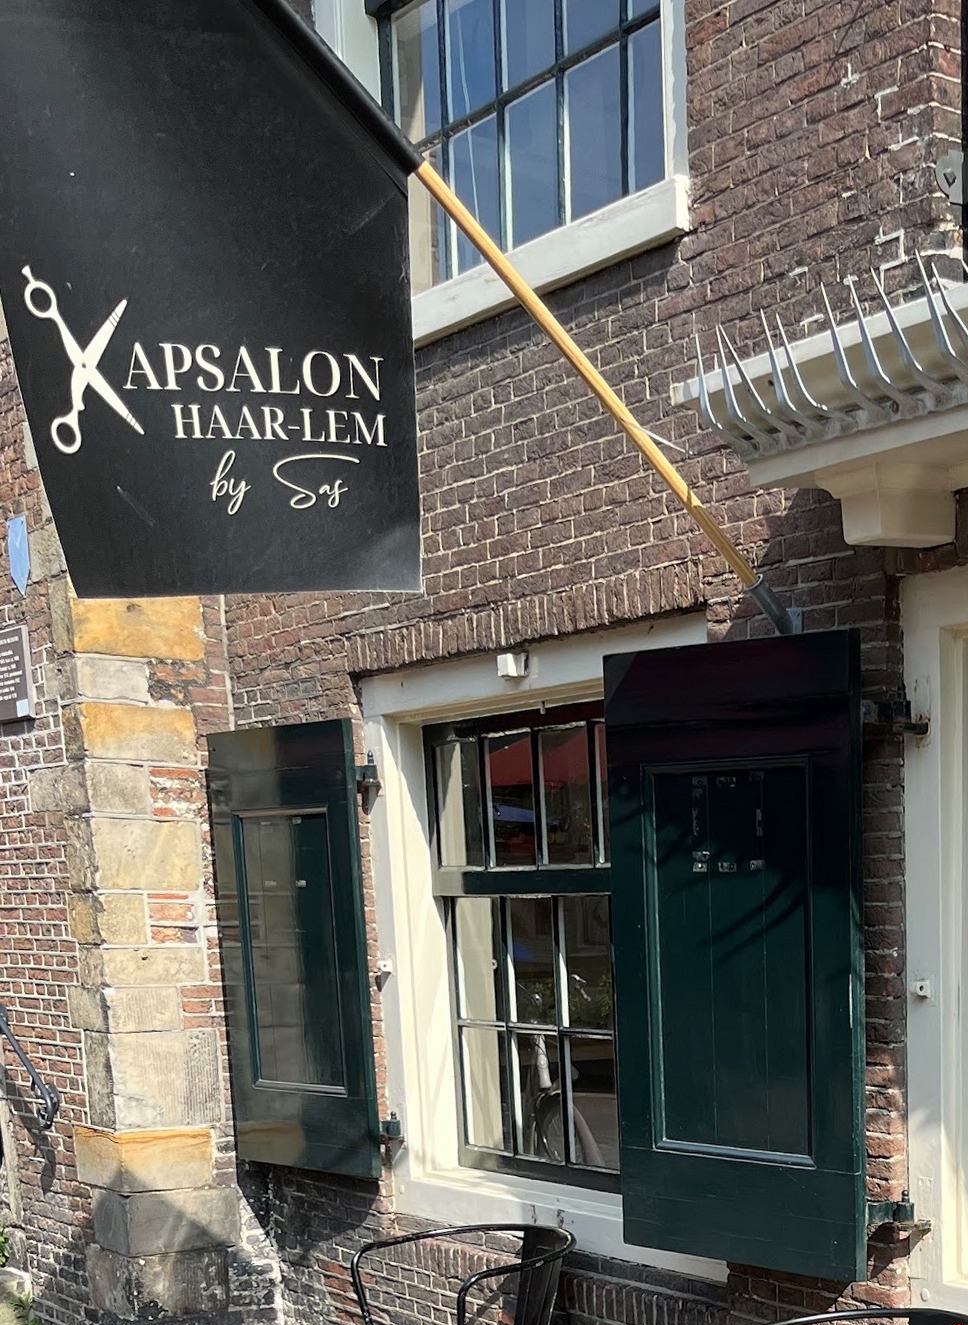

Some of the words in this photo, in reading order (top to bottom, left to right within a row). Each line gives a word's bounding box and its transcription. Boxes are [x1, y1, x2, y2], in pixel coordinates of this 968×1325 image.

[171, 403, 388, 446] HAAR-LEM
[210, 450, 252, 515] by
[272, 453, 361, 510] Sas
